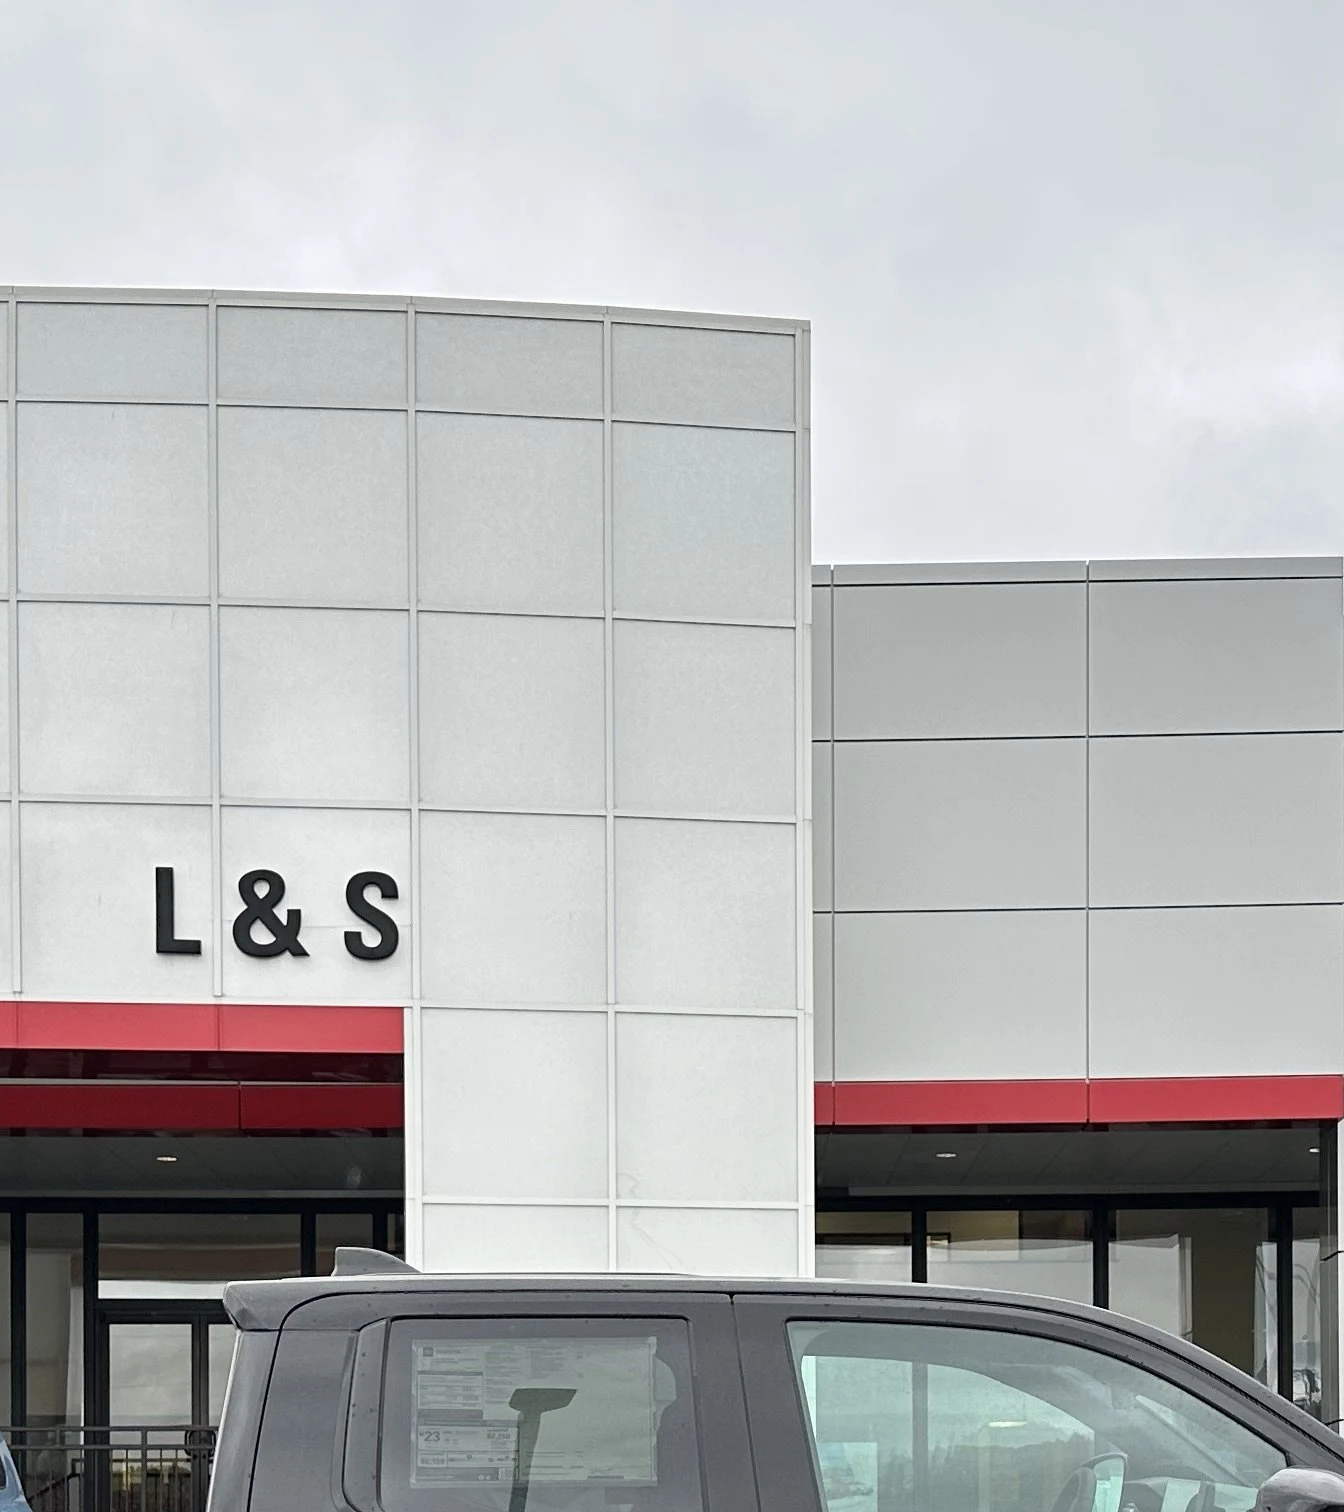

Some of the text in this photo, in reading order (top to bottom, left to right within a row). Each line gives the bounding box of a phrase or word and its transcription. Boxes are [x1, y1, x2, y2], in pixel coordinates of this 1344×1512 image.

[155, 866, 399, 961] L & S
